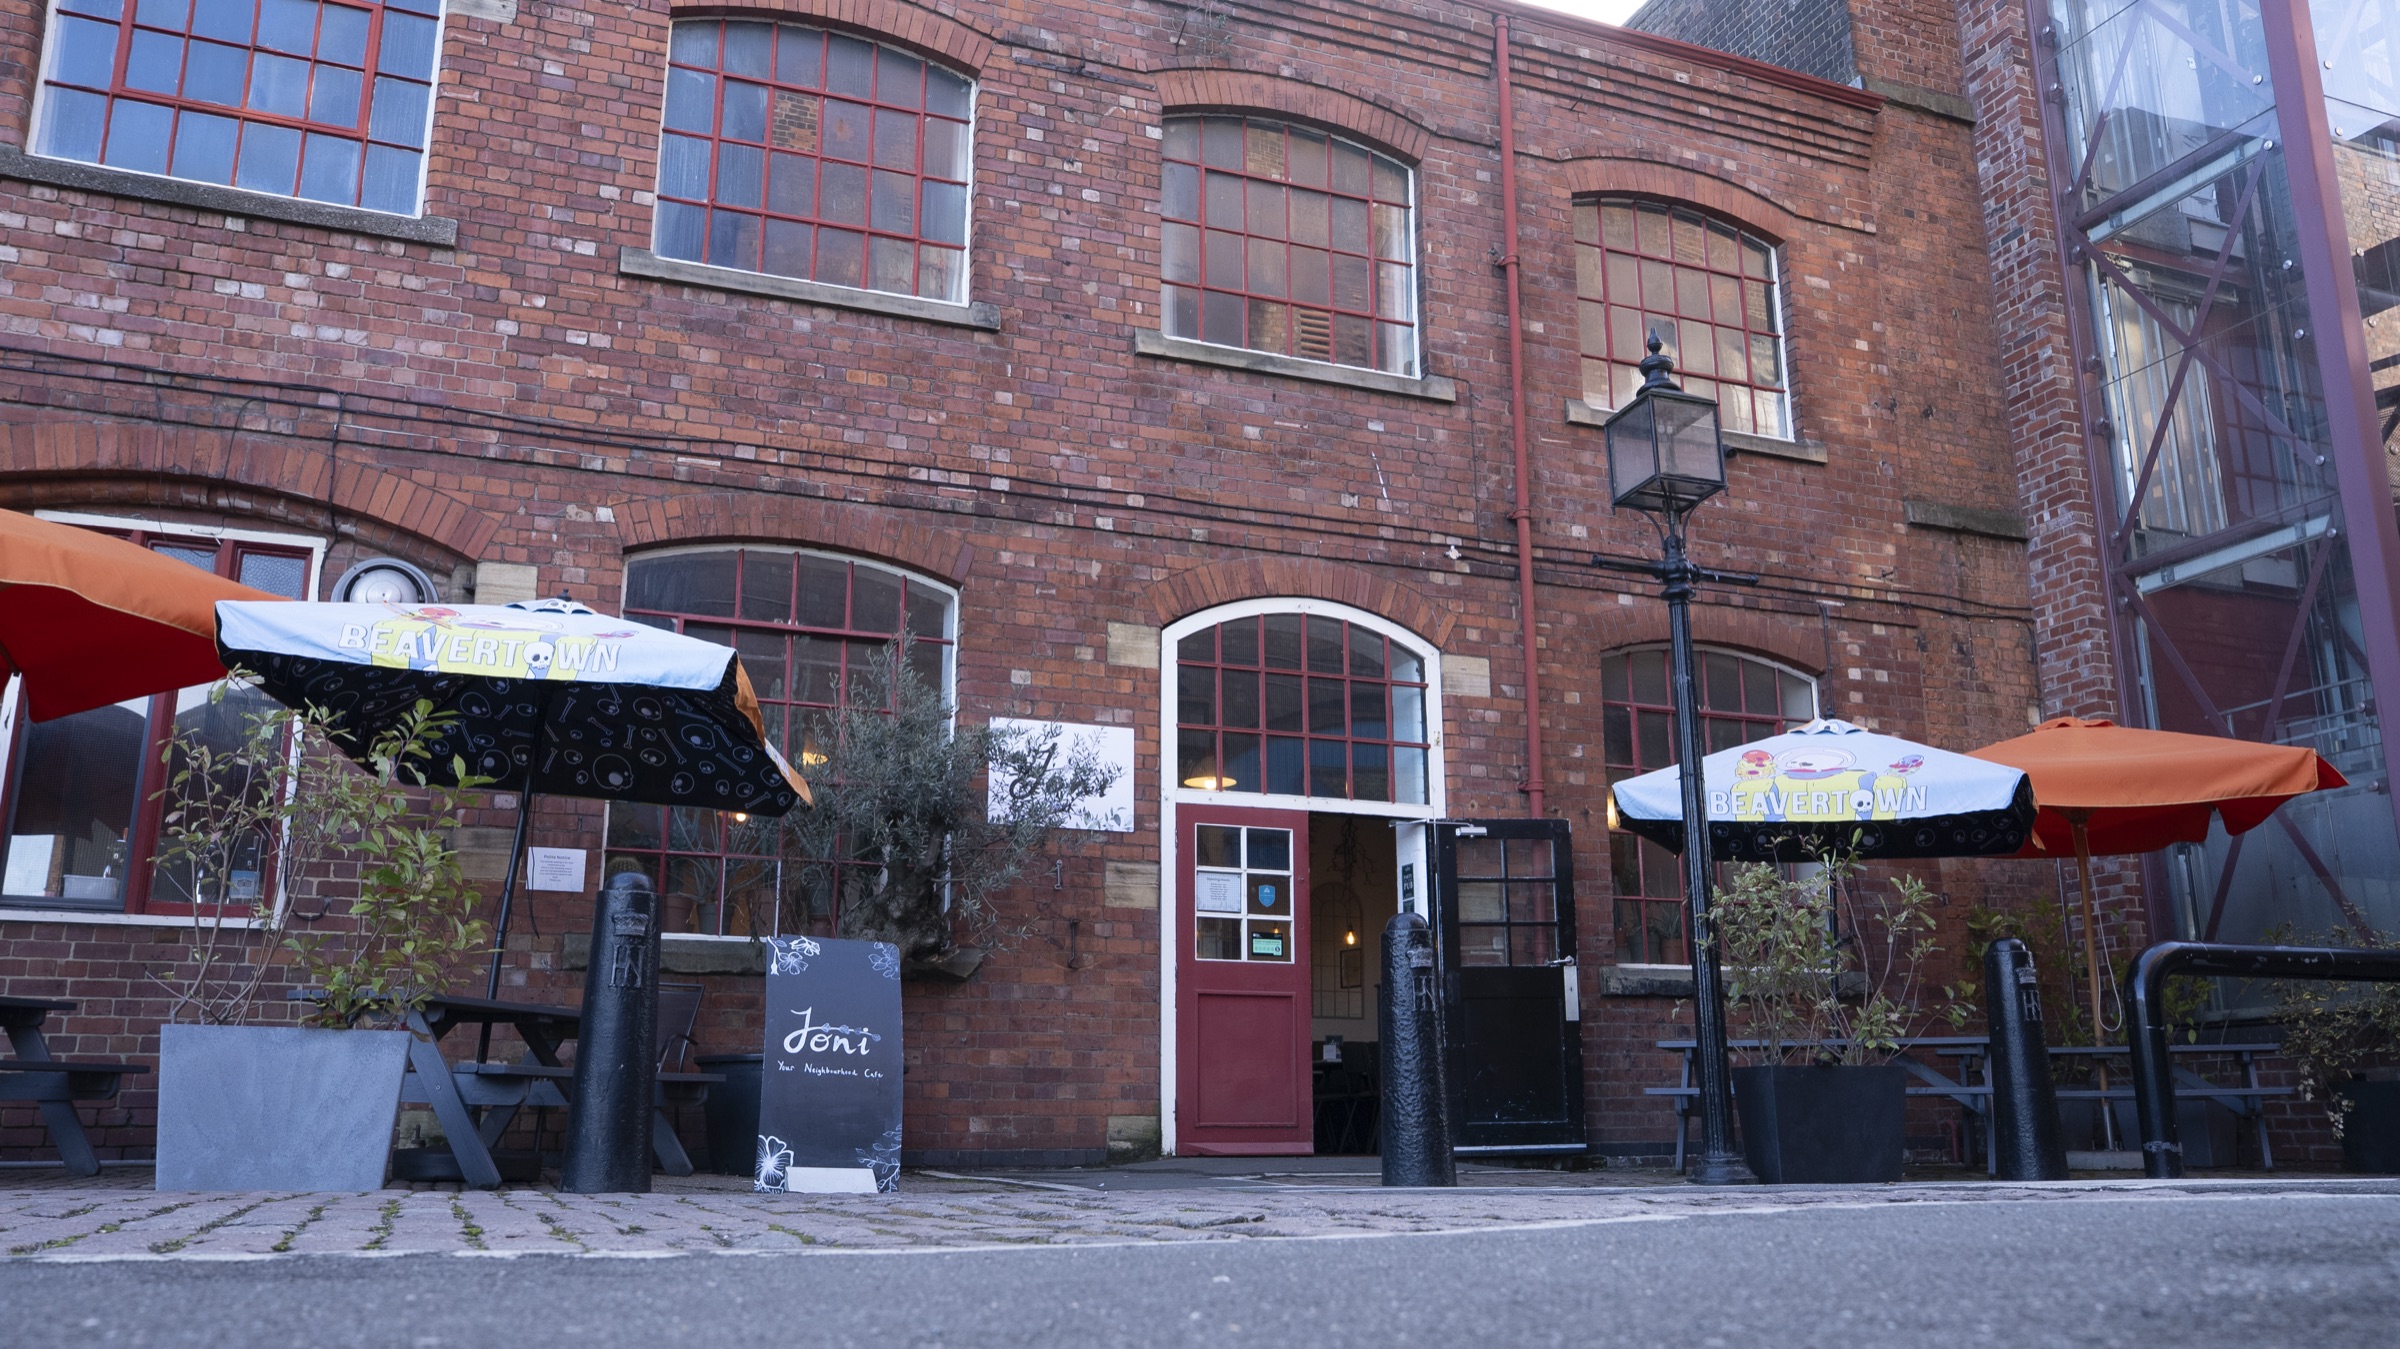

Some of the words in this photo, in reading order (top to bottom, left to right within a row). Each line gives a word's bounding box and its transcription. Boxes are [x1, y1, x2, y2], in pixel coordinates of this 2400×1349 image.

[783, 1006, 877, 1055] Joni
[777, 1060, 795, 1071] Your
[804, 1063, 858, 1077] Neighbourhood
